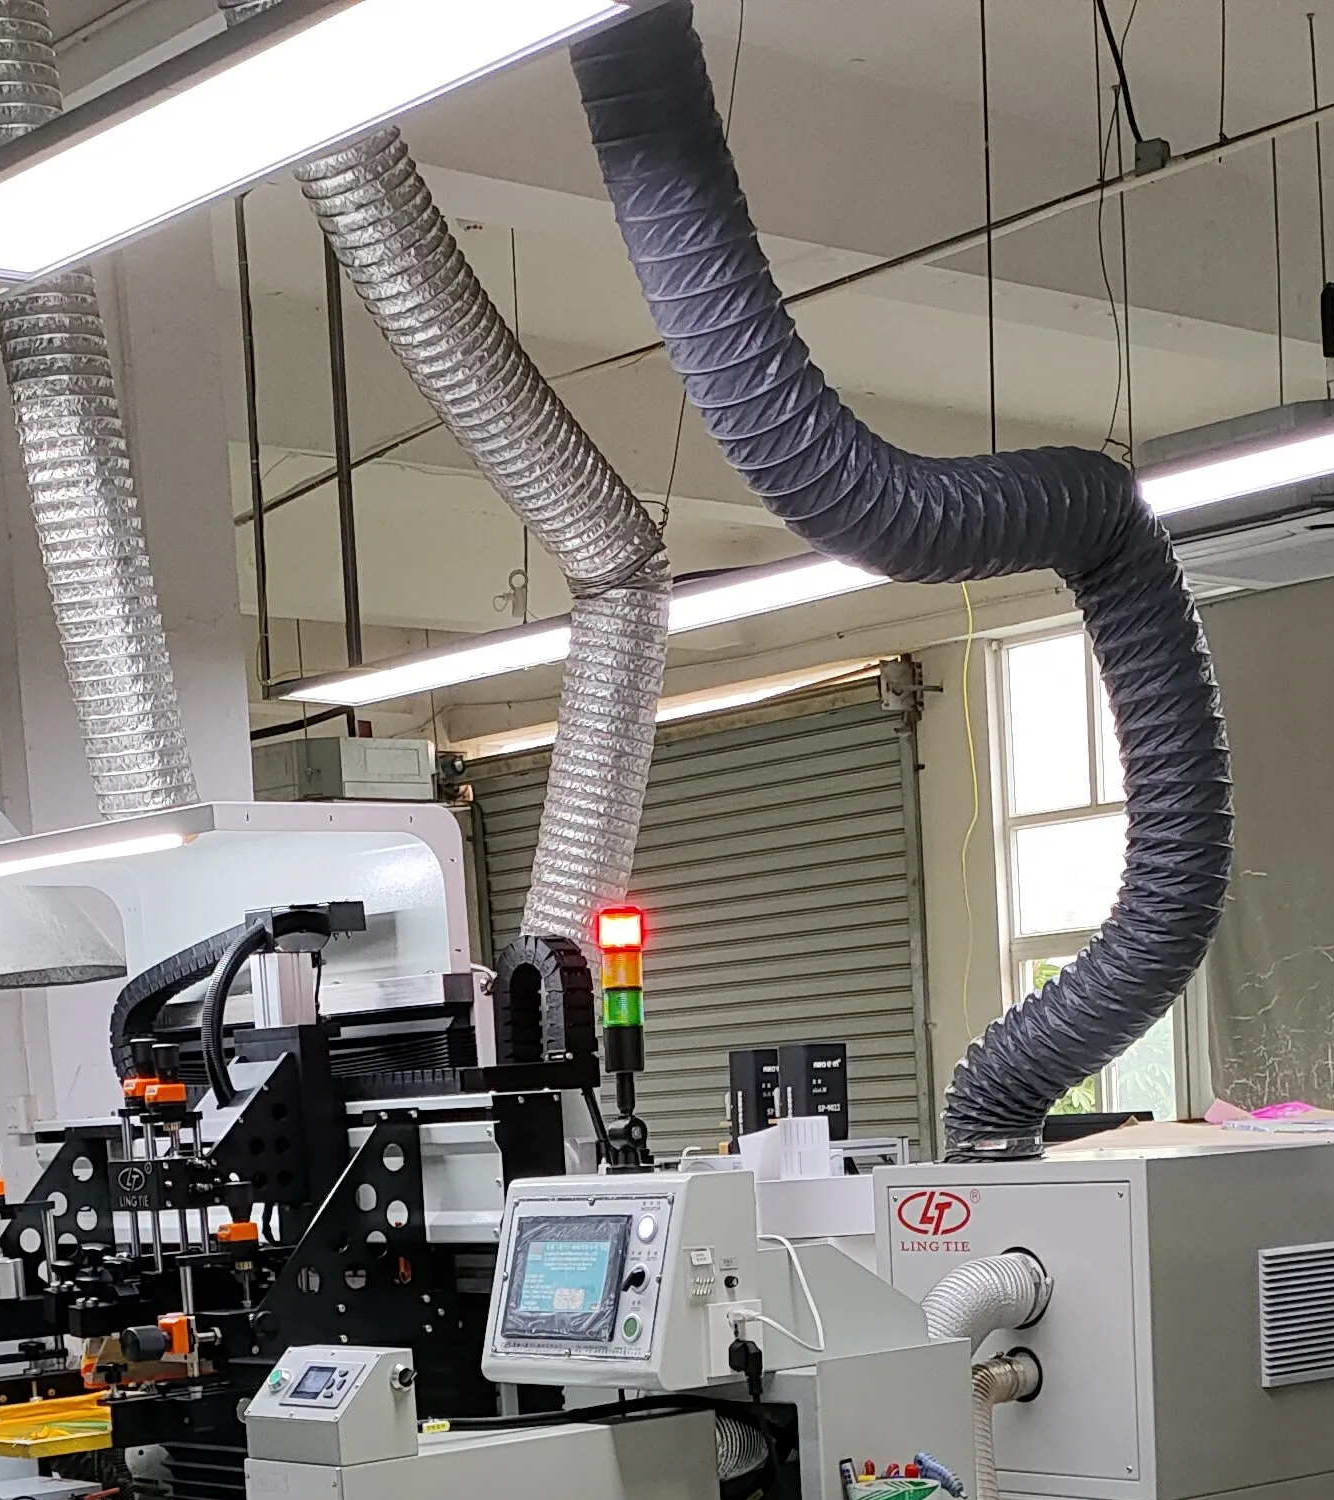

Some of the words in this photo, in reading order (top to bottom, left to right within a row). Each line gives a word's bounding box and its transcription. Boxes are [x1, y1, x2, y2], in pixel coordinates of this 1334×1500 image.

[119, 1195, 137, 1208] LING
[138, 1194, 150, 1208] TIE
[900, 1241, 939, 1252] LING
[943, 1241, 971, 1252] TIE
